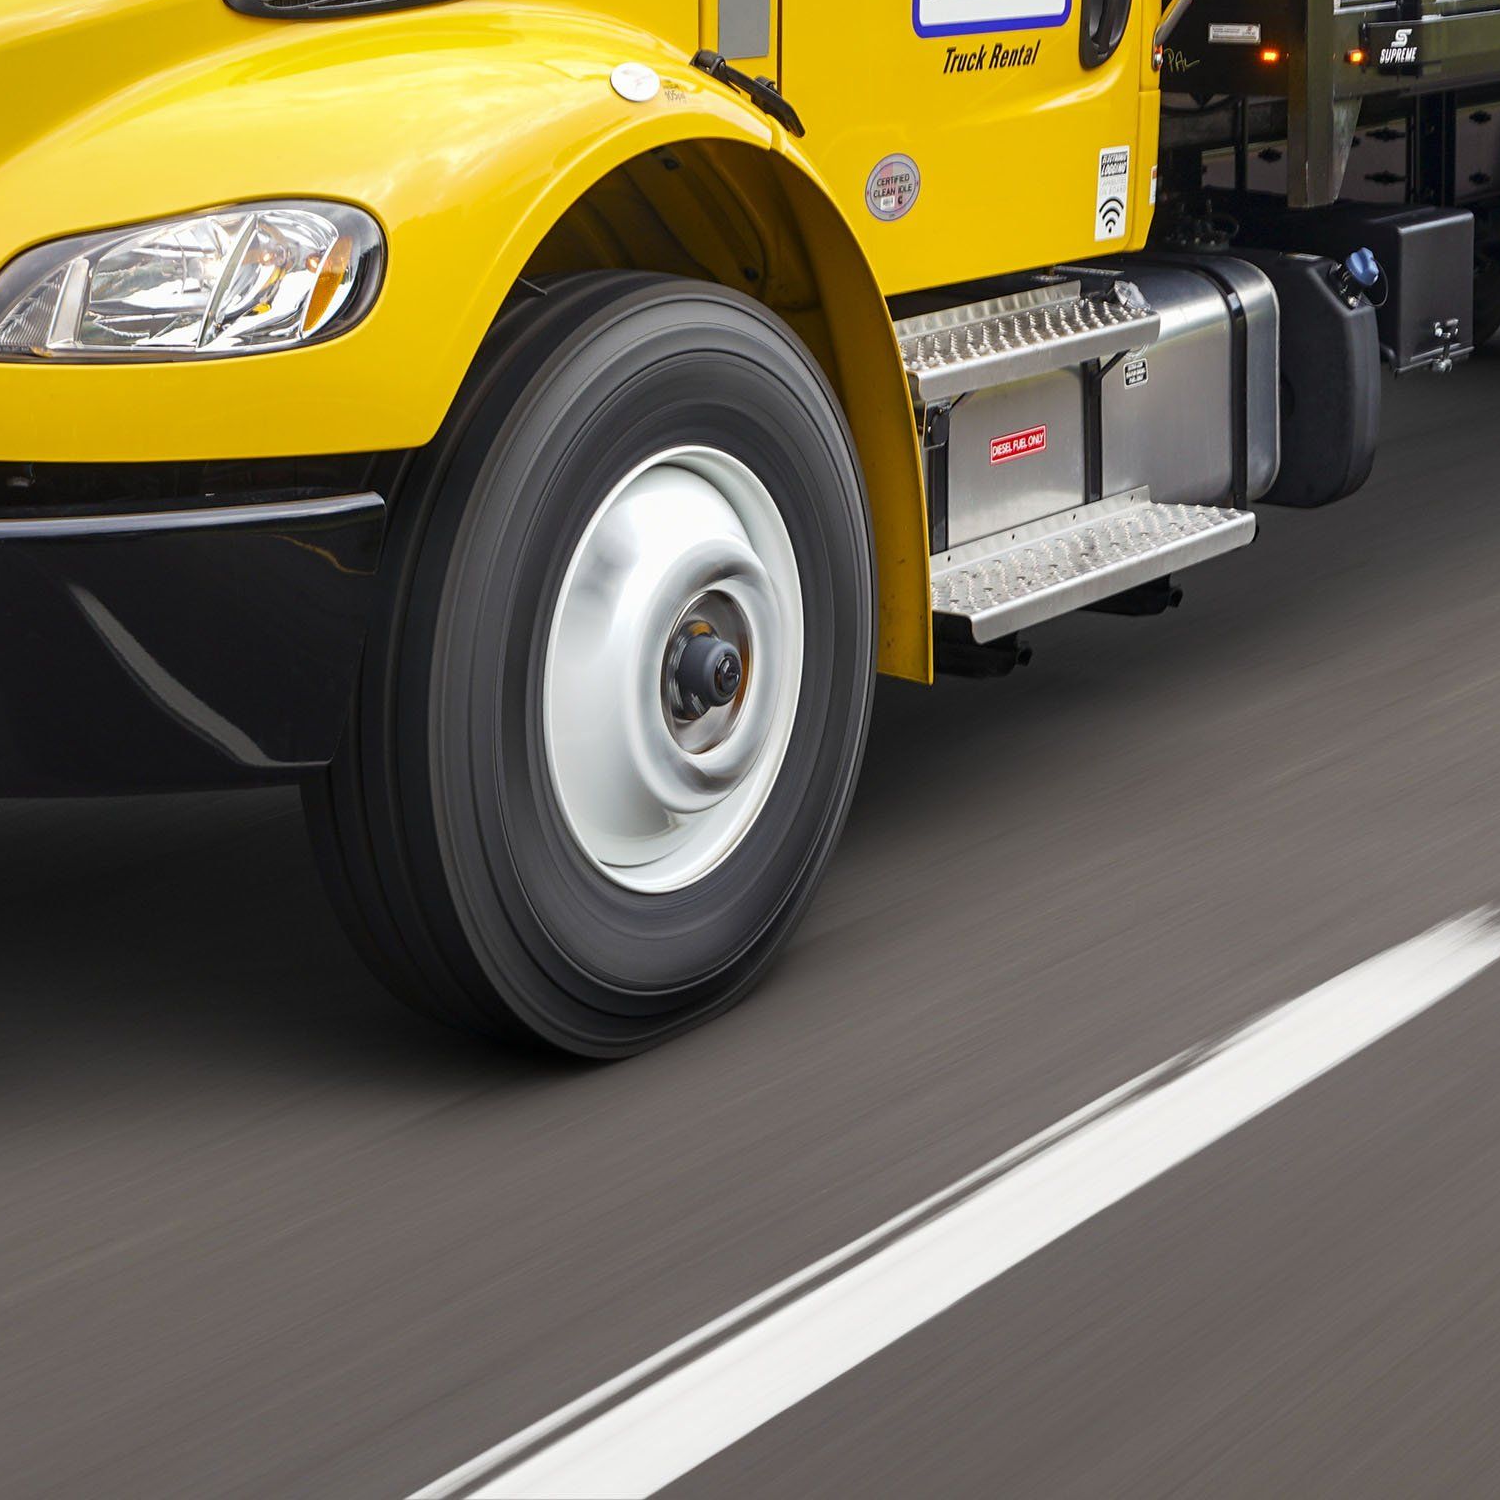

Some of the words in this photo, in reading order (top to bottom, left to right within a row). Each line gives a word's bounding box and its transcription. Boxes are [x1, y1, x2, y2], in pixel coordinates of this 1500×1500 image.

[943, 43, 988, 75] Truck
[988, 38, 1042, 70] Rental
[1379, 46, 1418, 65] SUPREME
[876, 173, 910, 187] CERTIFIED
[873, 187, 896, 198] CLEAN
[897, 183, 913, 194] IDLE
[992, 441, 1012, 457] DIESEL
[1012, 437, 1028, 453] FUEL
[1027, 432, 1044, 448] ONLY
